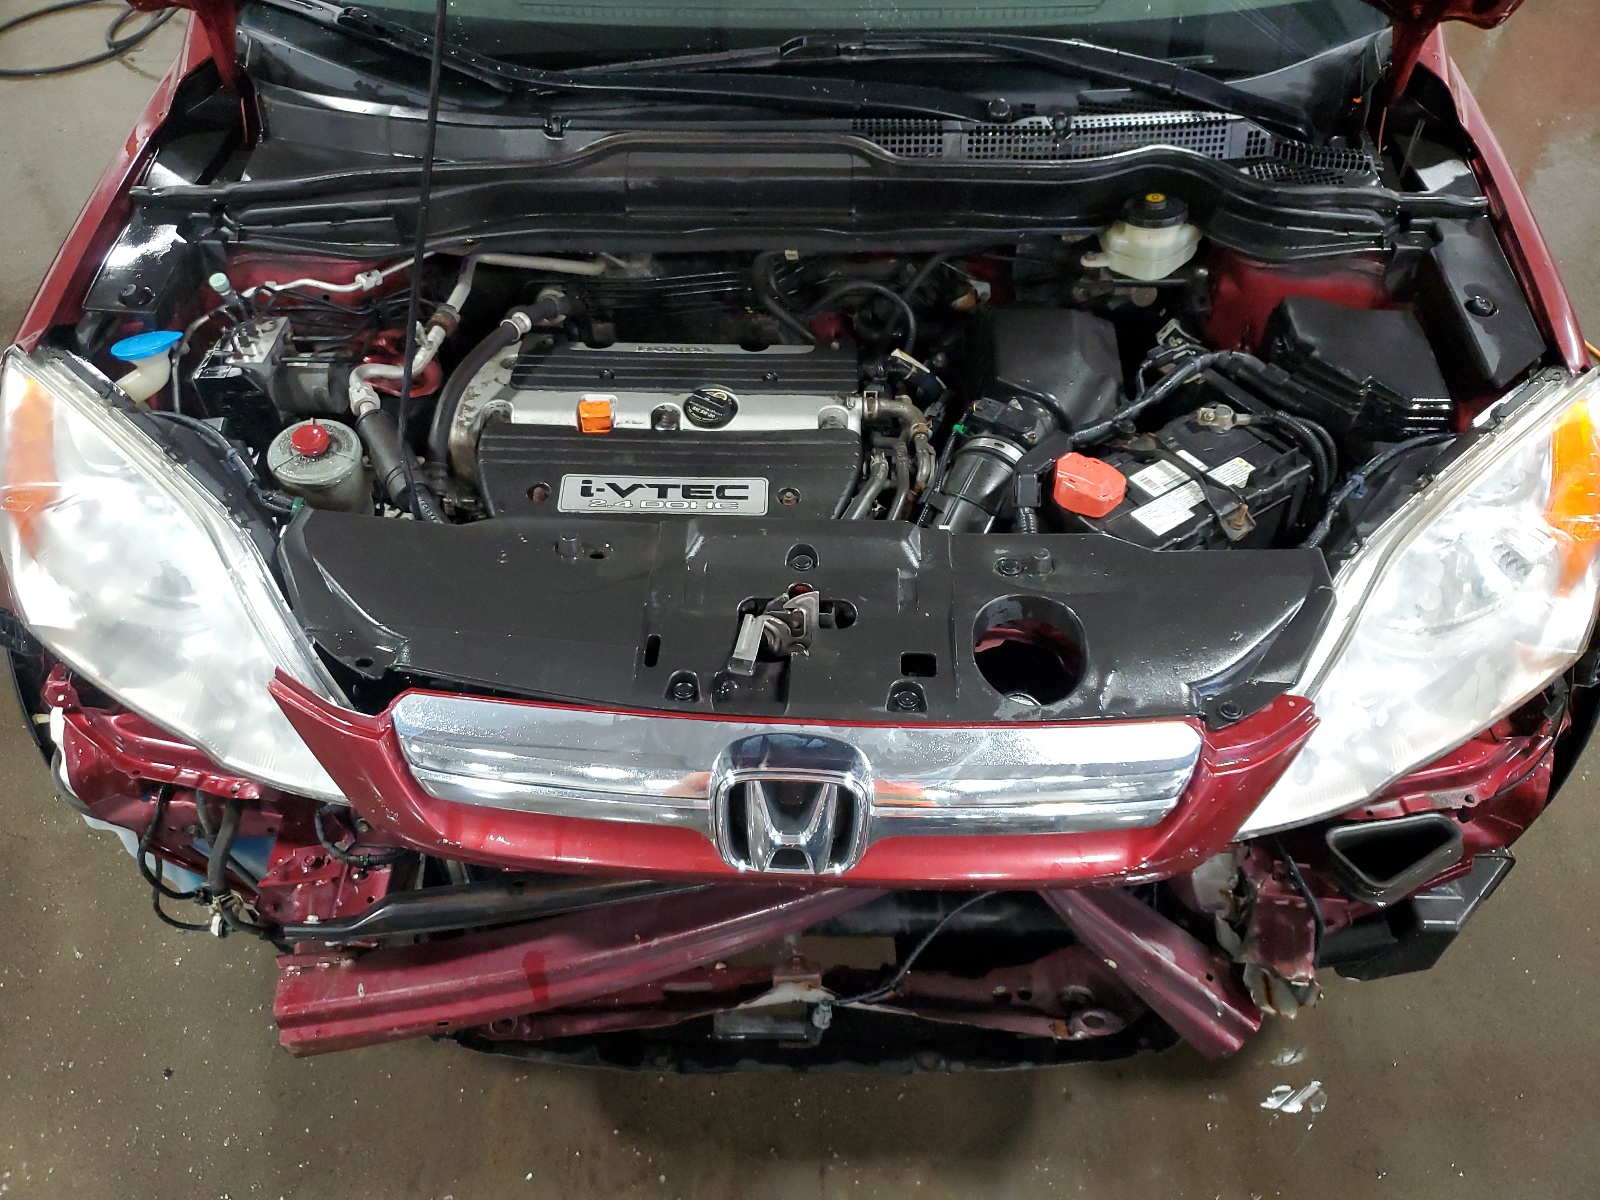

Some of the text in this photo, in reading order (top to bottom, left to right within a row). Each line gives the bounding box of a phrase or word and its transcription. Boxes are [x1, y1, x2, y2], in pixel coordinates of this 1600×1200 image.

[635, 346, 714, 354] HONDA
[580, 480, 749, 500] i-VTEC
[588, 499, 739, 510] 2.4 DOHC
